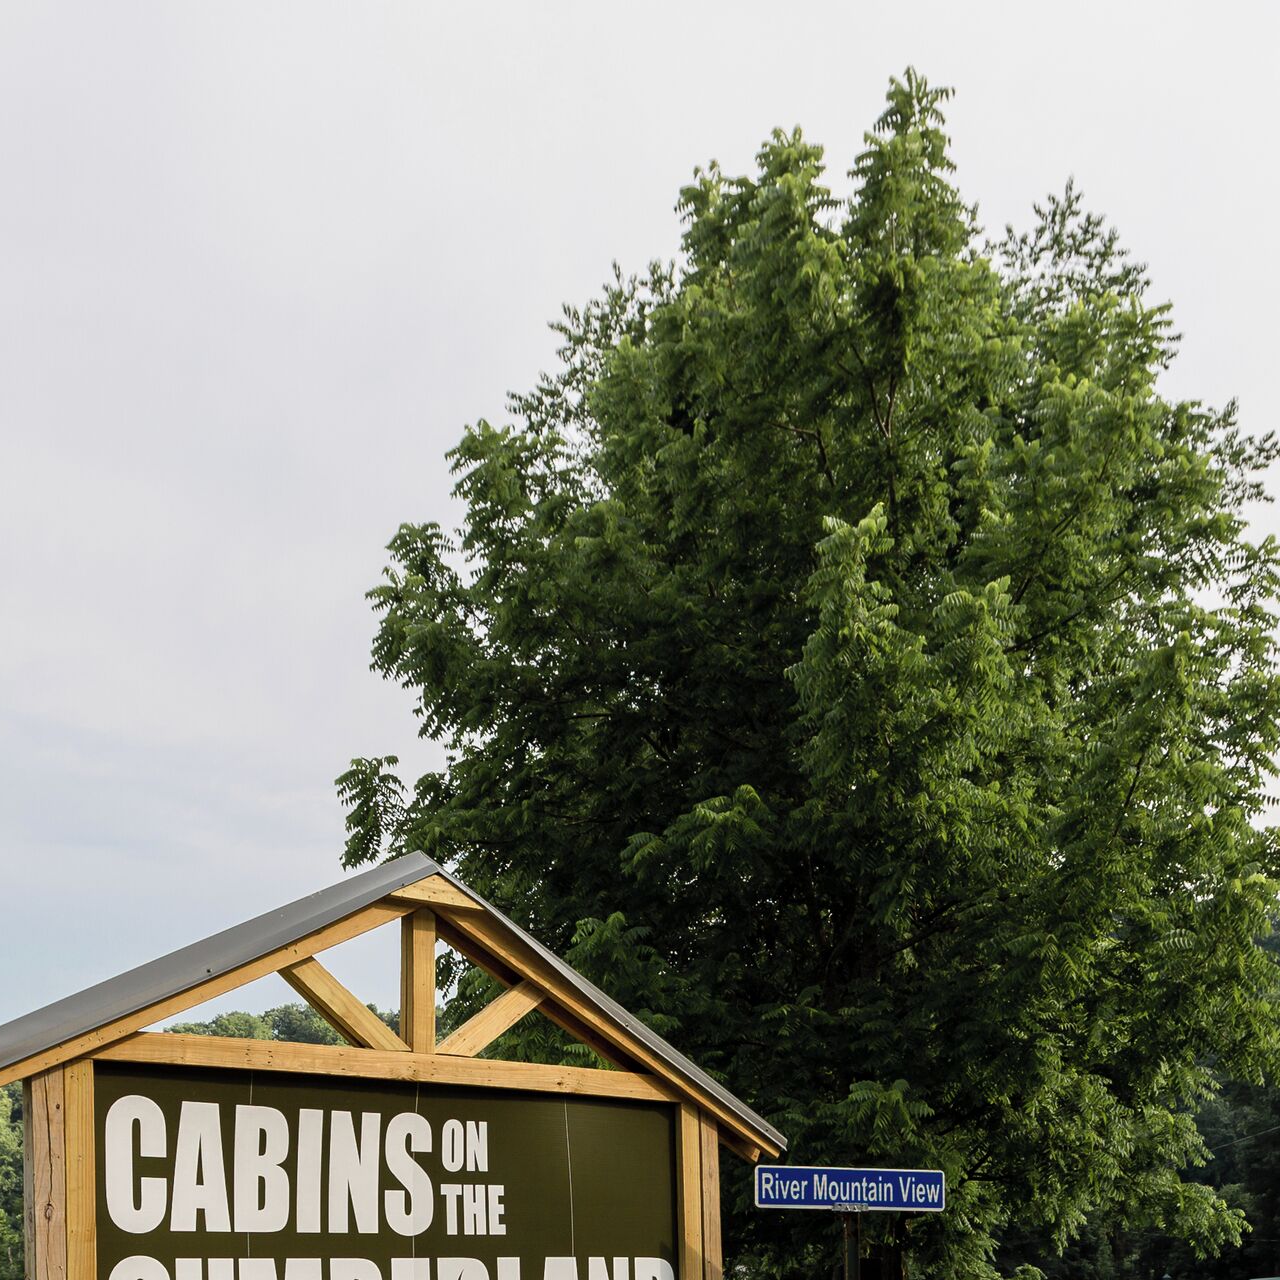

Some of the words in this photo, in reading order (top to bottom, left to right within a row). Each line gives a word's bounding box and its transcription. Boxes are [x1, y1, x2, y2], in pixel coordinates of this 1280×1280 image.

[104, 1094, 434, 1236] CABINS
[442, 1119, 488, 1172] ON
[440, 1184, 506, 1236] THE
[761, 1173, 808, 1200] River
[813, 1174, 893, 1202] Mountain
[899, 1176, 941, 1203] View
